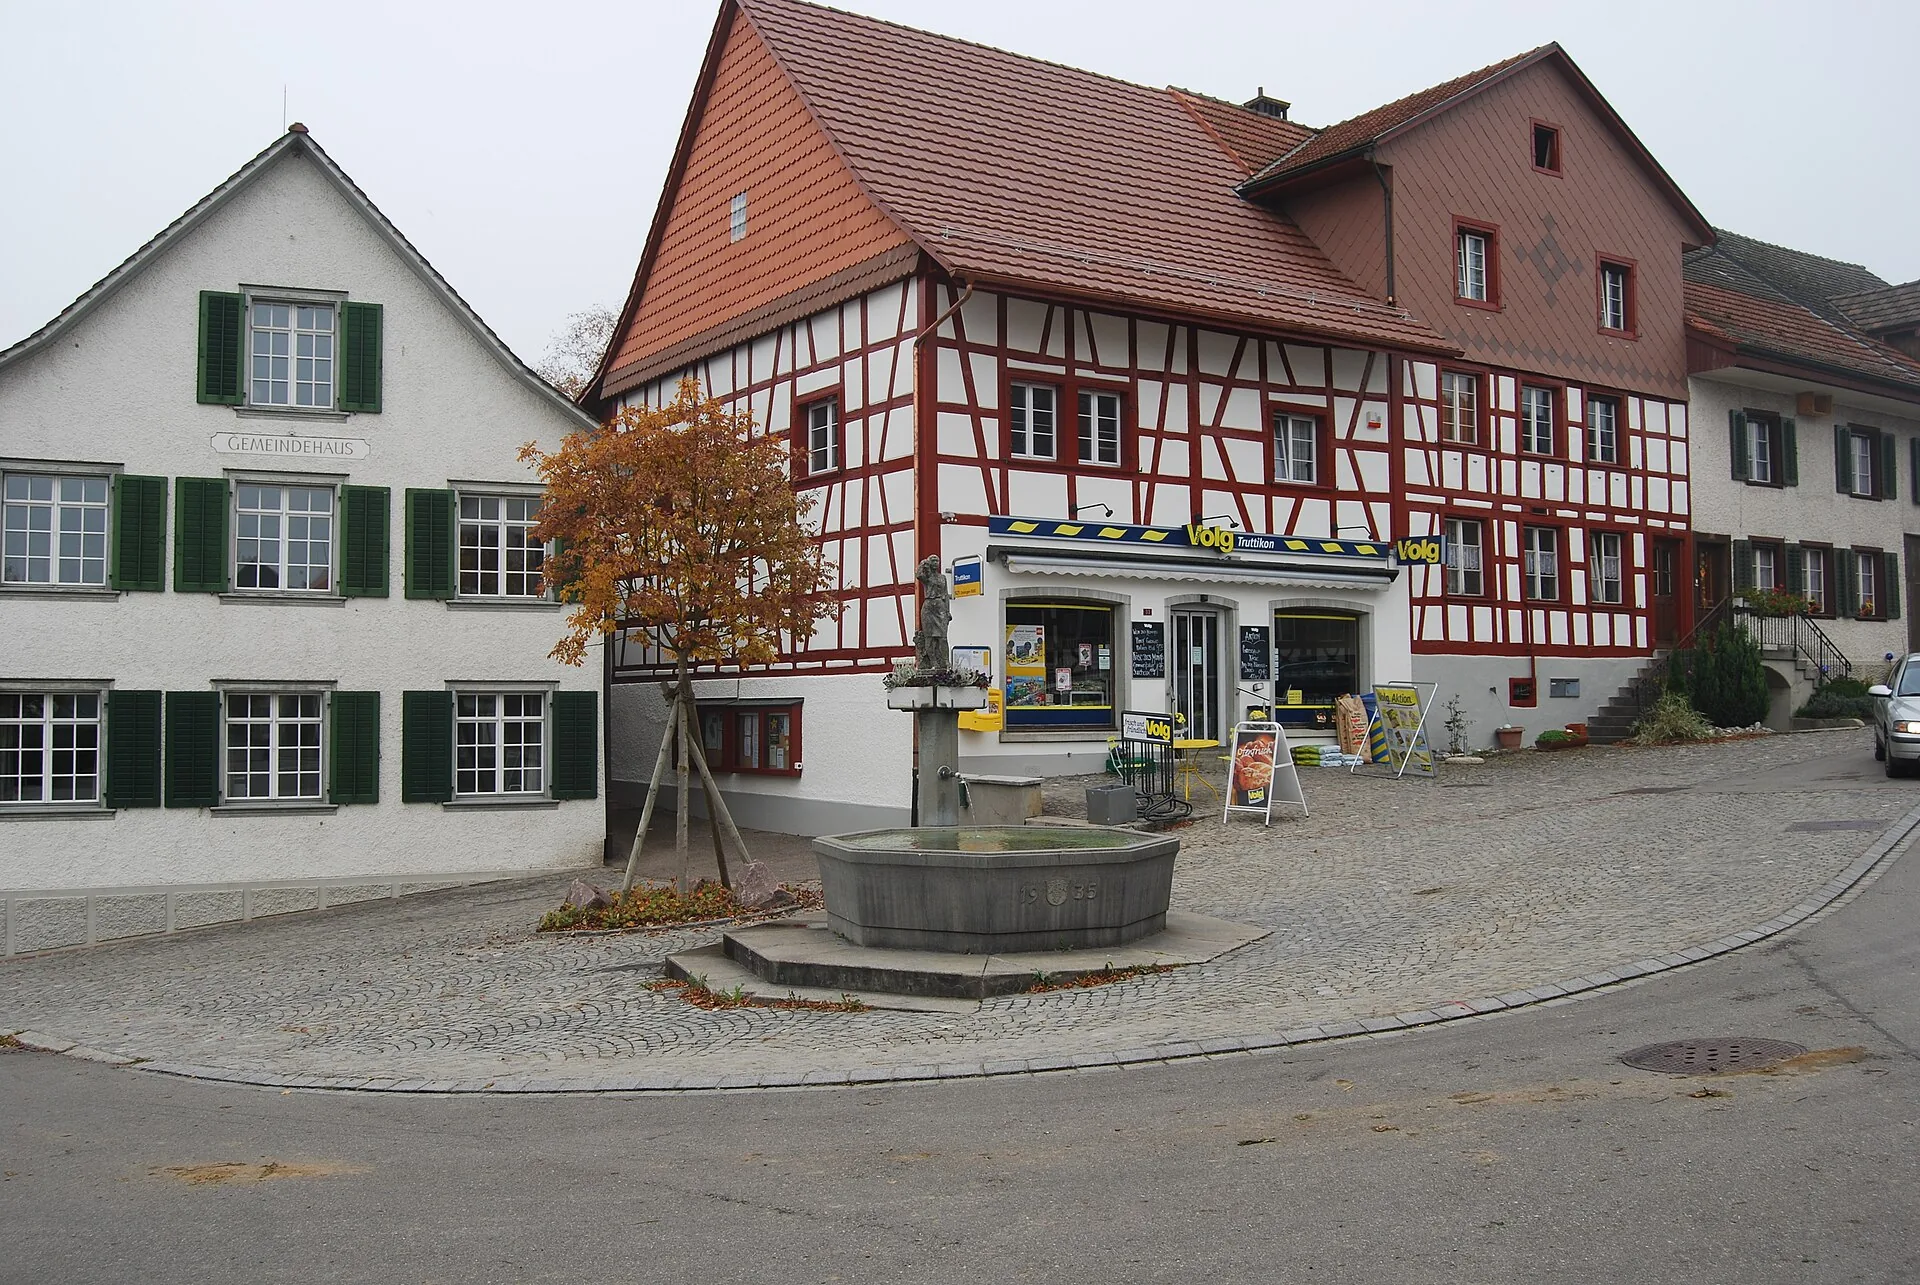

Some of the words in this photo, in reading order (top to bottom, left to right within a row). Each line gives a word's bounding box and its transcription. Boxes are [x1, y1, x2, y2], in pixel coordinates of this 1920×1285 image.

[228, 436, 353, 455] GEMEINDEHAUS
[1187, 524, 1234, 553] Volg
[1237, 536, 1275, 549] Truttikon
[1397, 539, 1439, 563] Volg
[1146, 720, 1170, 740] Volg
[1249, 790, 1264, 800] Volg
